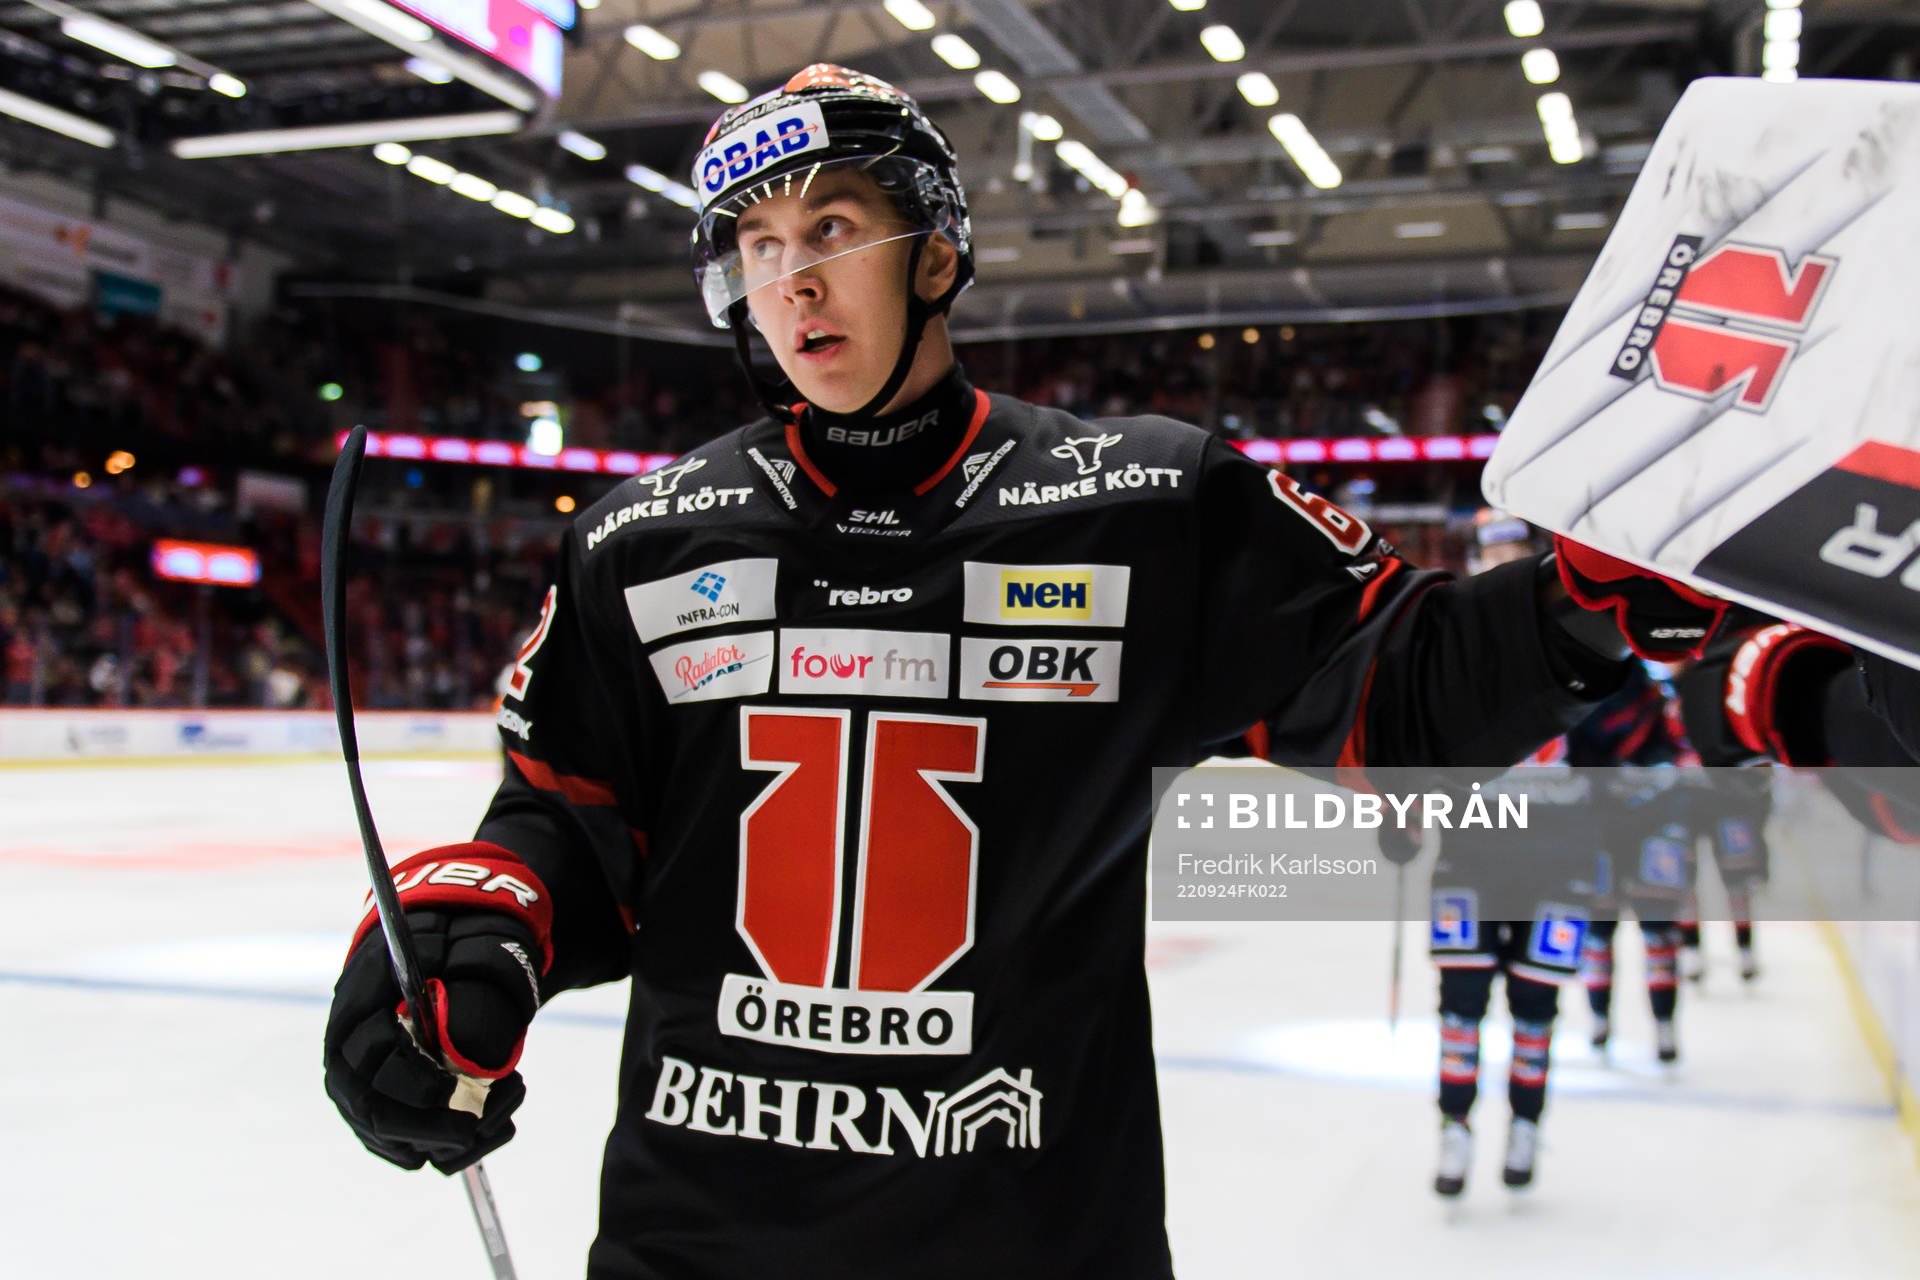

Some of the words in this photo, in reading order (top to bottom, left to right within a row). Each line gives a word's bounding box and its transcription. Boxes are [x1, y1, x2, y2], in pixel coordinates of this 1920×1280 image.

[702, 117, 811, 193] ÖBAB
[1617, 243, 1696, 371] ÖREBRO
[999, 476, 1098, 506] NÄRKE
[1104, 463, 1183, 492] KÖTT
[587, 499, 669, 550] NÄRKE
[676, 487, 753, 515] KÖTT
[848, 509, 901, 525] SHL
[676, 602, 740, 626] INFRA-CON
[675, 644, 746, 689] Radiator
[791, 646, 874, 679] four
[883, 649, 937, 682] fm
[988, 645, 1099, 682] OBK
[736, 984, 953, 1047] ÖREBRO
[645, 1056, 946, 1159] BEHRN
